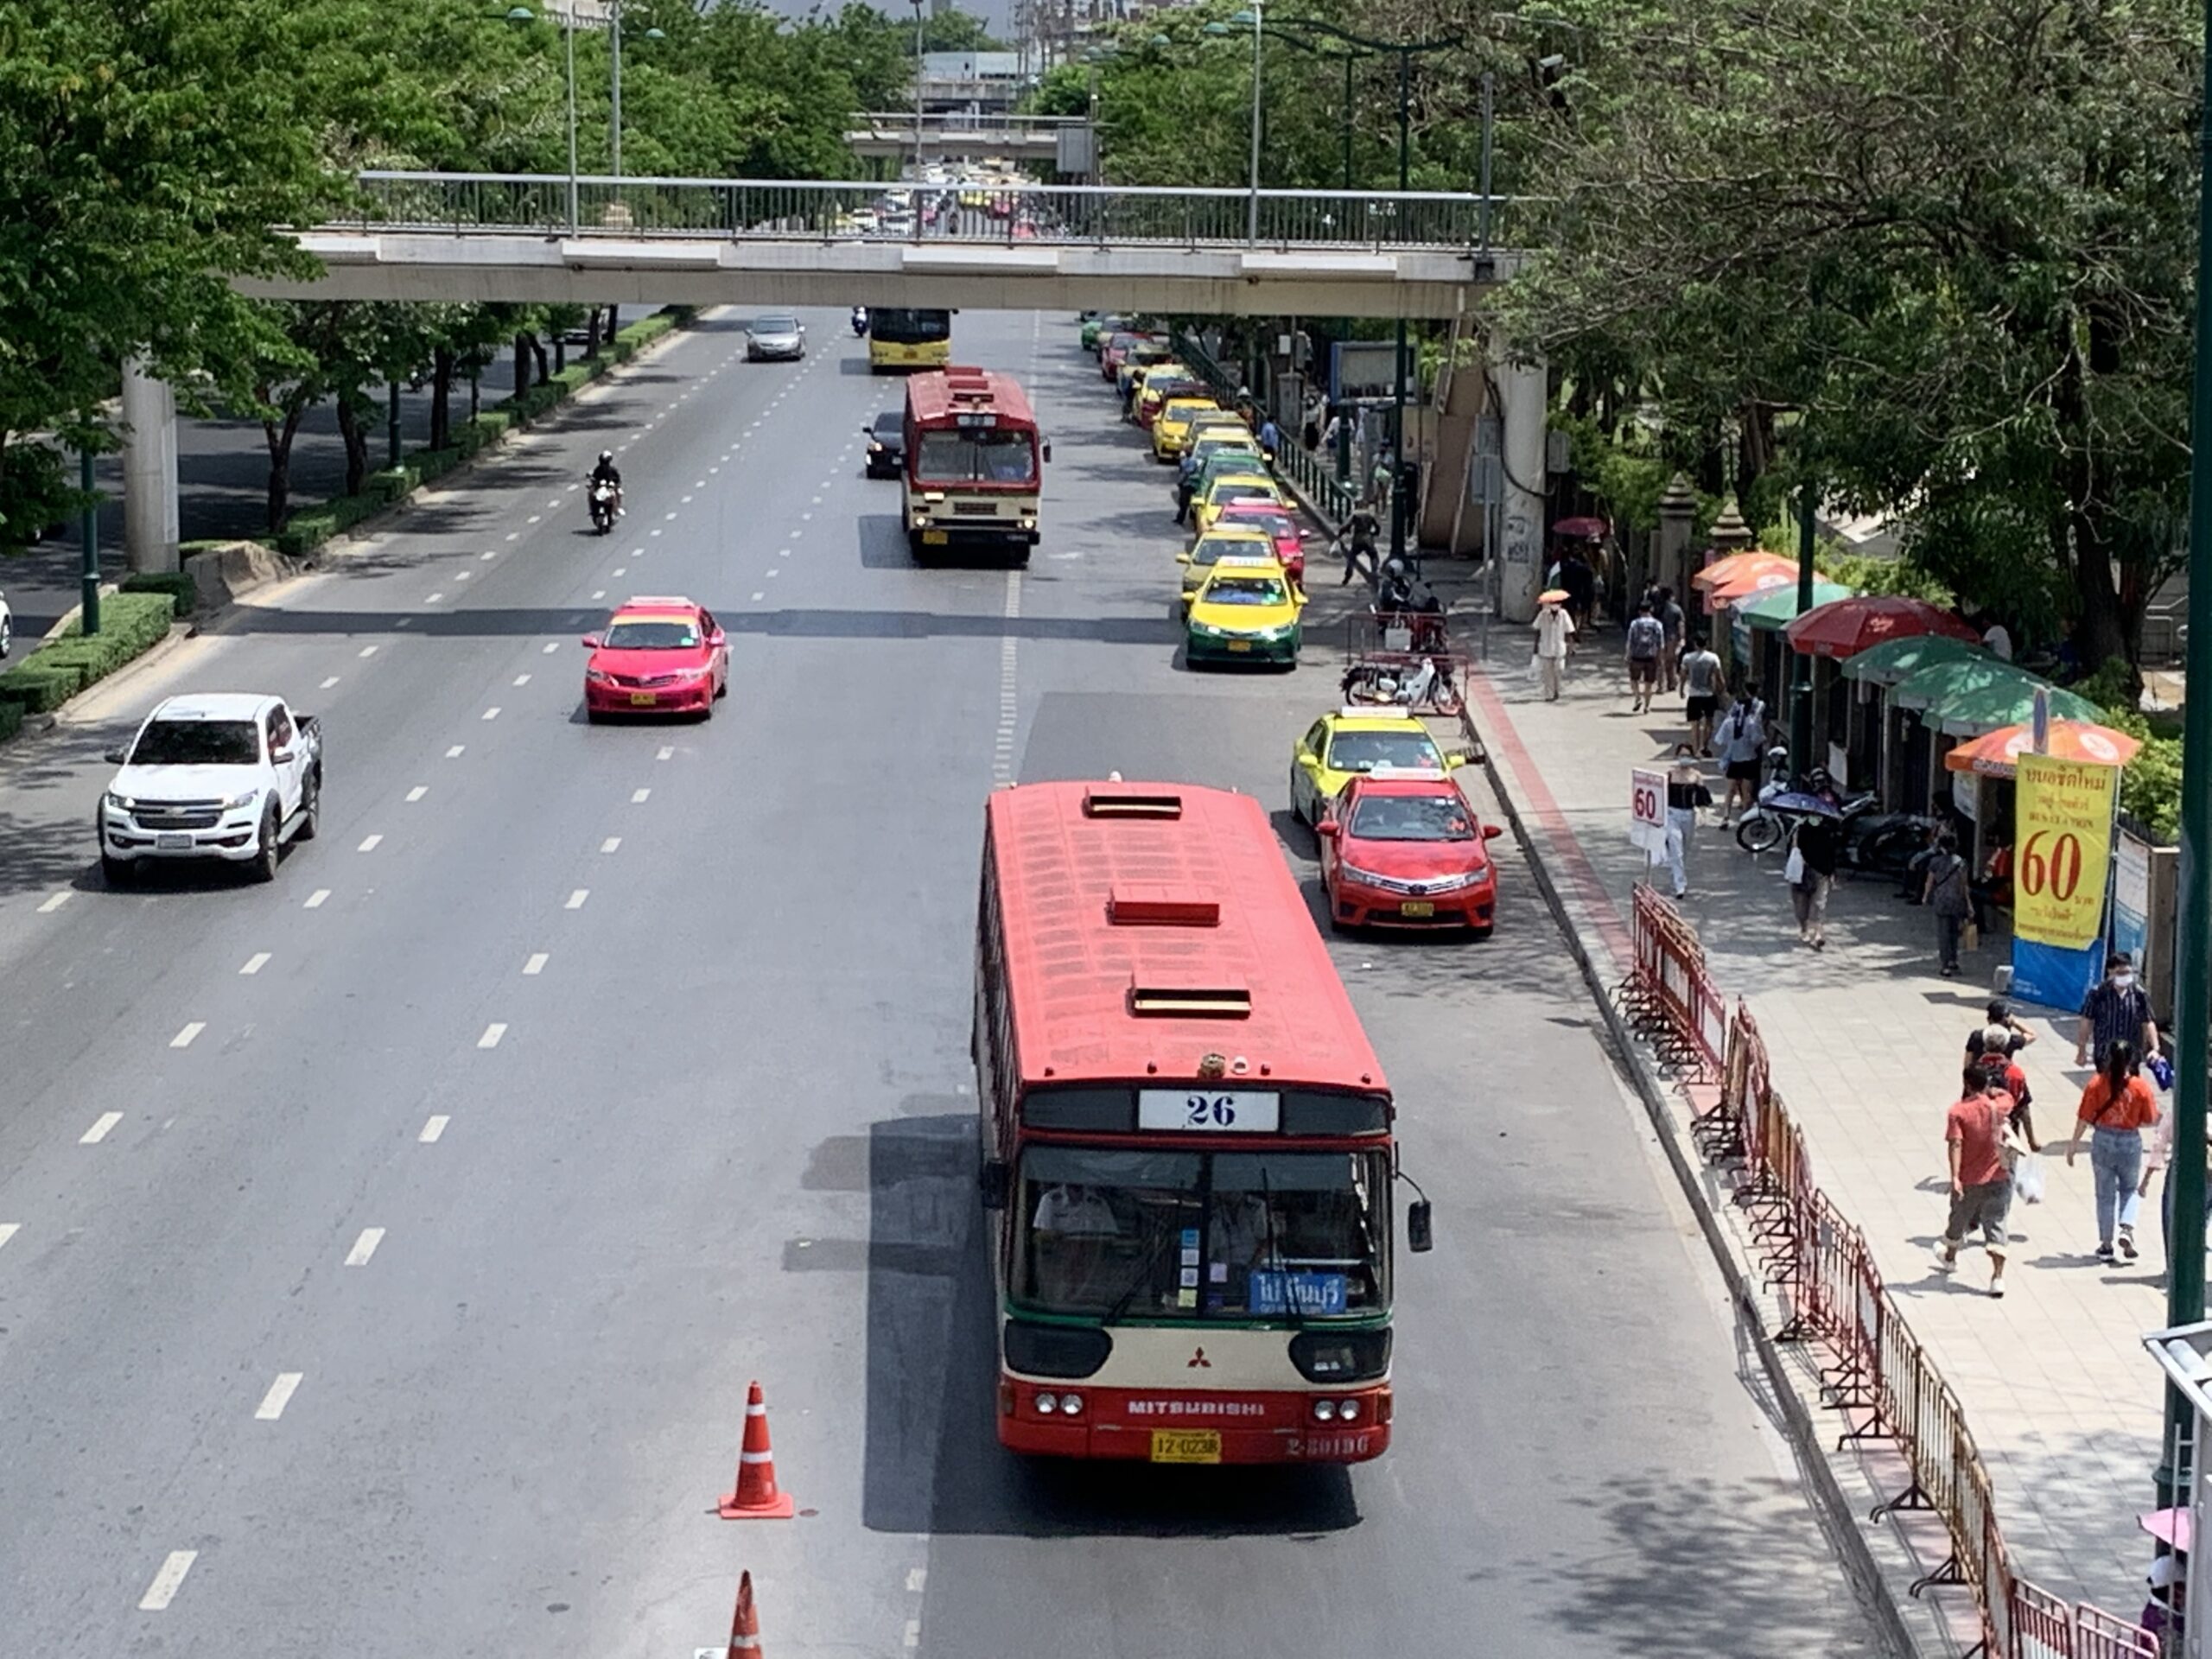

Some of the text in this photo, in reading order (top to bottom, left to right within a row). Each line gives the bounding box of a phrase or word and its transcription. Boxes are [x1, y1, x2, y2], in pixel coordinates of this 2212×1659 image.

[1635, 788, 1656, 819] 60
[2022, 830, 2082, 901] 60
[1186, 1096, 1236, 1126] 26
[1128, 1401, 1265, 1415] MITSUBISHI
